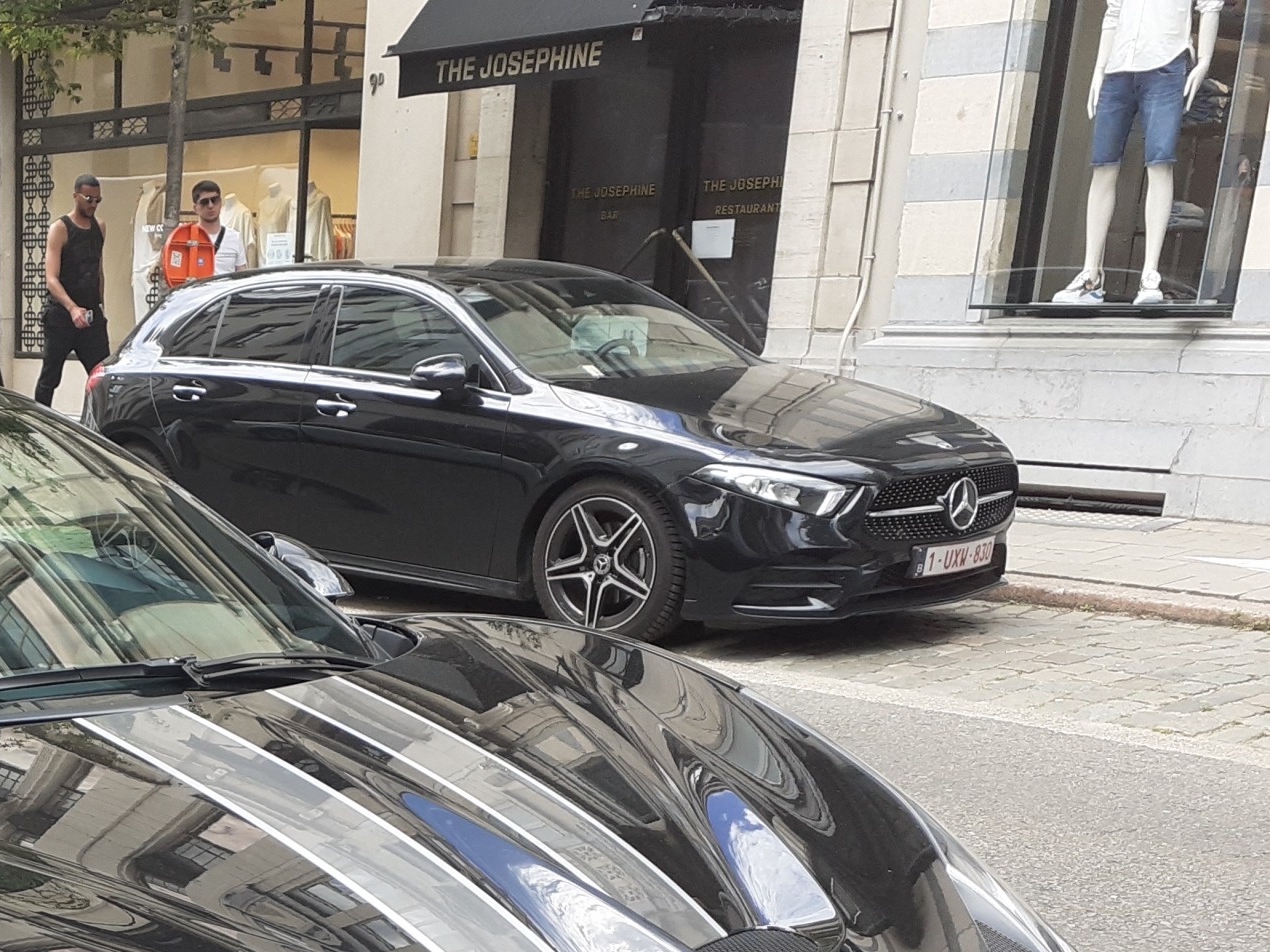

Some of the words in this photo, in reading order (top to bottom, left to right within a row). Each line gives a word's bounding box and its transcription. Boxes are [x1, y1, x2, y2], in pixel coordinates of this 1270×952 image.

[437, 57, 477, 84] THE
[480, 40, 605, 79] JOSEPHINE
[571, 186, 591, 199] THE
[594, 183, 656, 198] JOSEPHINE
[704, 179, 727, 193] THE
[600, 210, 619, 221] BAR
[715, 202, 782, 216] RESTAURANT
[928, 541, 993, 572] 1-UXW-830
